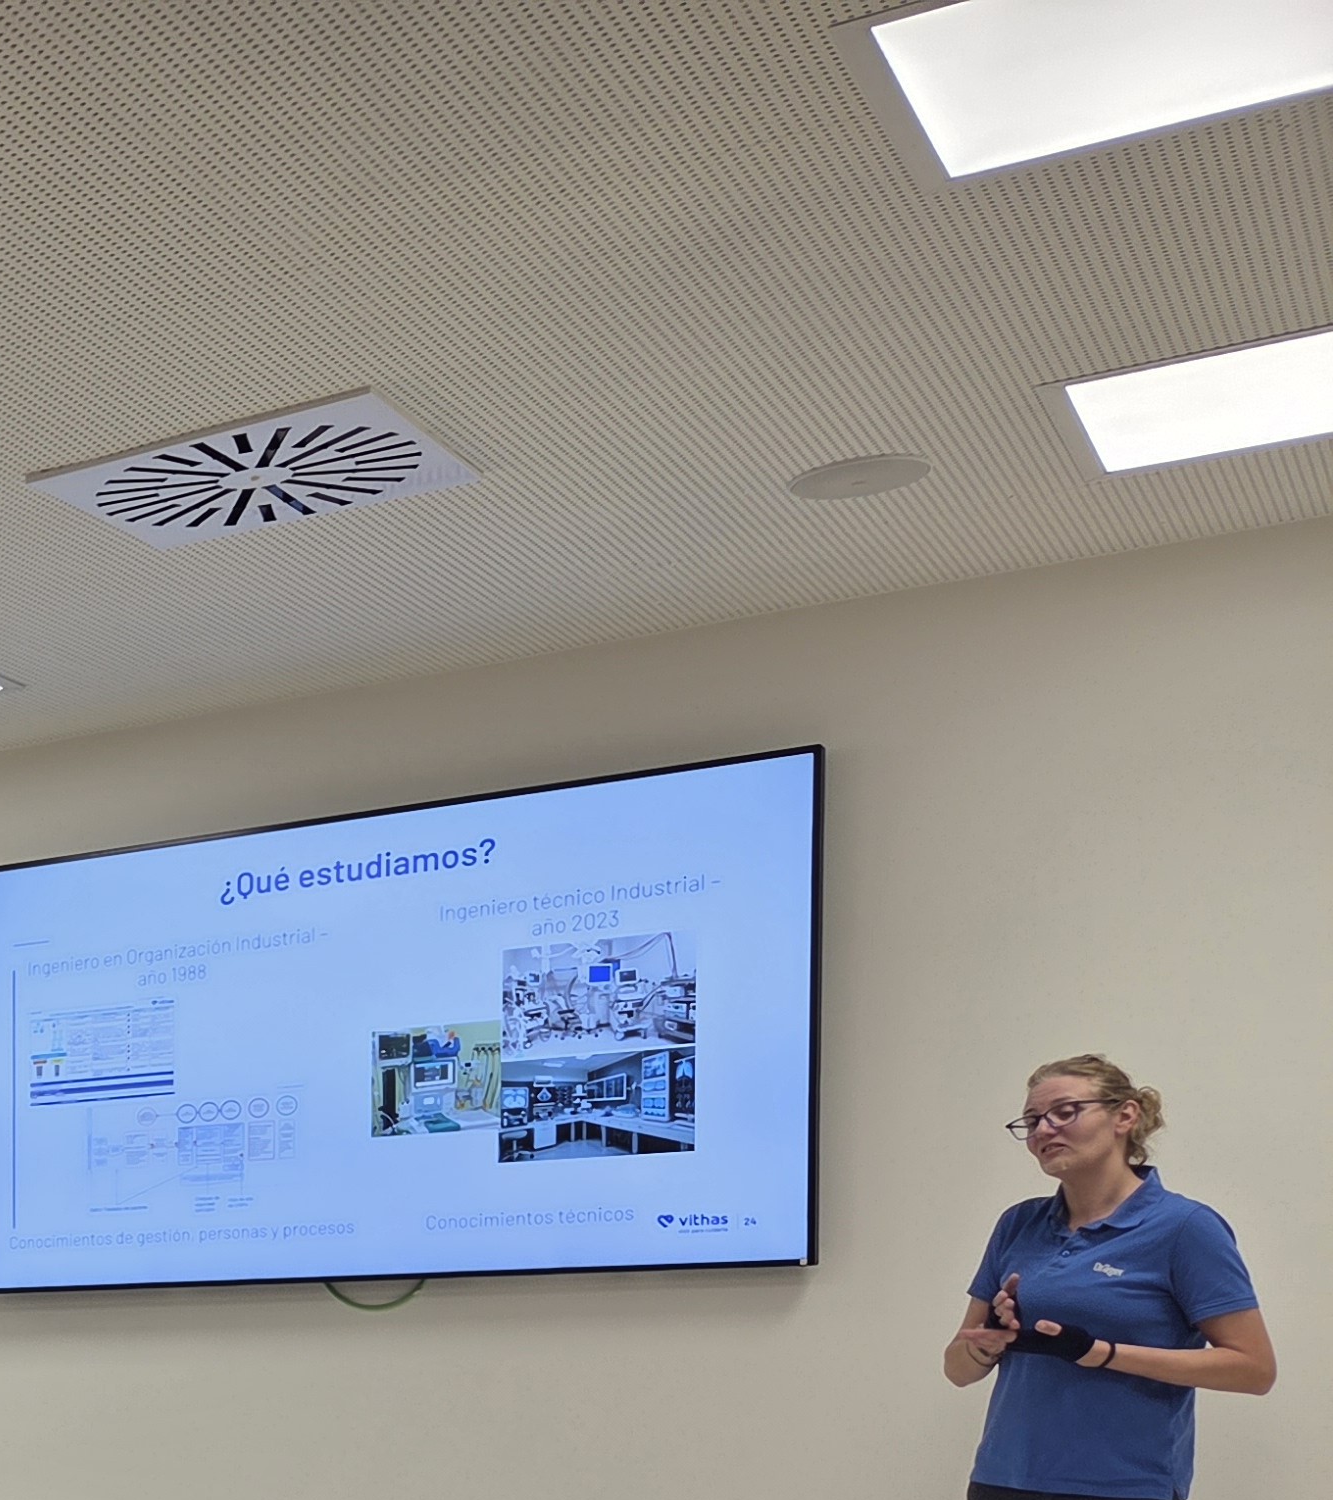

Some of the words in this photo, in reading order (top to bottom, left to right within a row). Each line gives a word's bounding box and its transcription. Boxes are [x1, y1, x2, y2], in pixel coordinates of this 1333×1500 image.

[220, 866, 290, 905] ¿Qué
[299, 838, 496, 888] estudiamos?
[439, 895, 528, 924] Ingeniero
[533, 885, 605, 911] técnico
[610, 874, 706, 902] Industrial
[531, 915, 567, 937] año
[571, 910, 620, 933] 2023
[27, 956, 100, 979] Ingeniero
[103, 953, 123, 969] en
[126, 939, 232, 966] Organización
[236, 927, 316, 951] Industrial
[137, 970, 168, 987] año
[171, 964, 207, 984] 1988
[425, 1212, 554, 1232] Conocimientos
[558, 1206, 635, 1225] técnicos
[678, 1214, 729, 1227] vithas
[743, 1217, 757, 1226] 24
[8, 1233, 113, 1251] Conocimientos
[116, 1231, 133, 1246] de
[199, 1226, 268, 1244] personas
[271, 1225, 280, 1241] y
[283, 1222, 355, 1240] procesos
